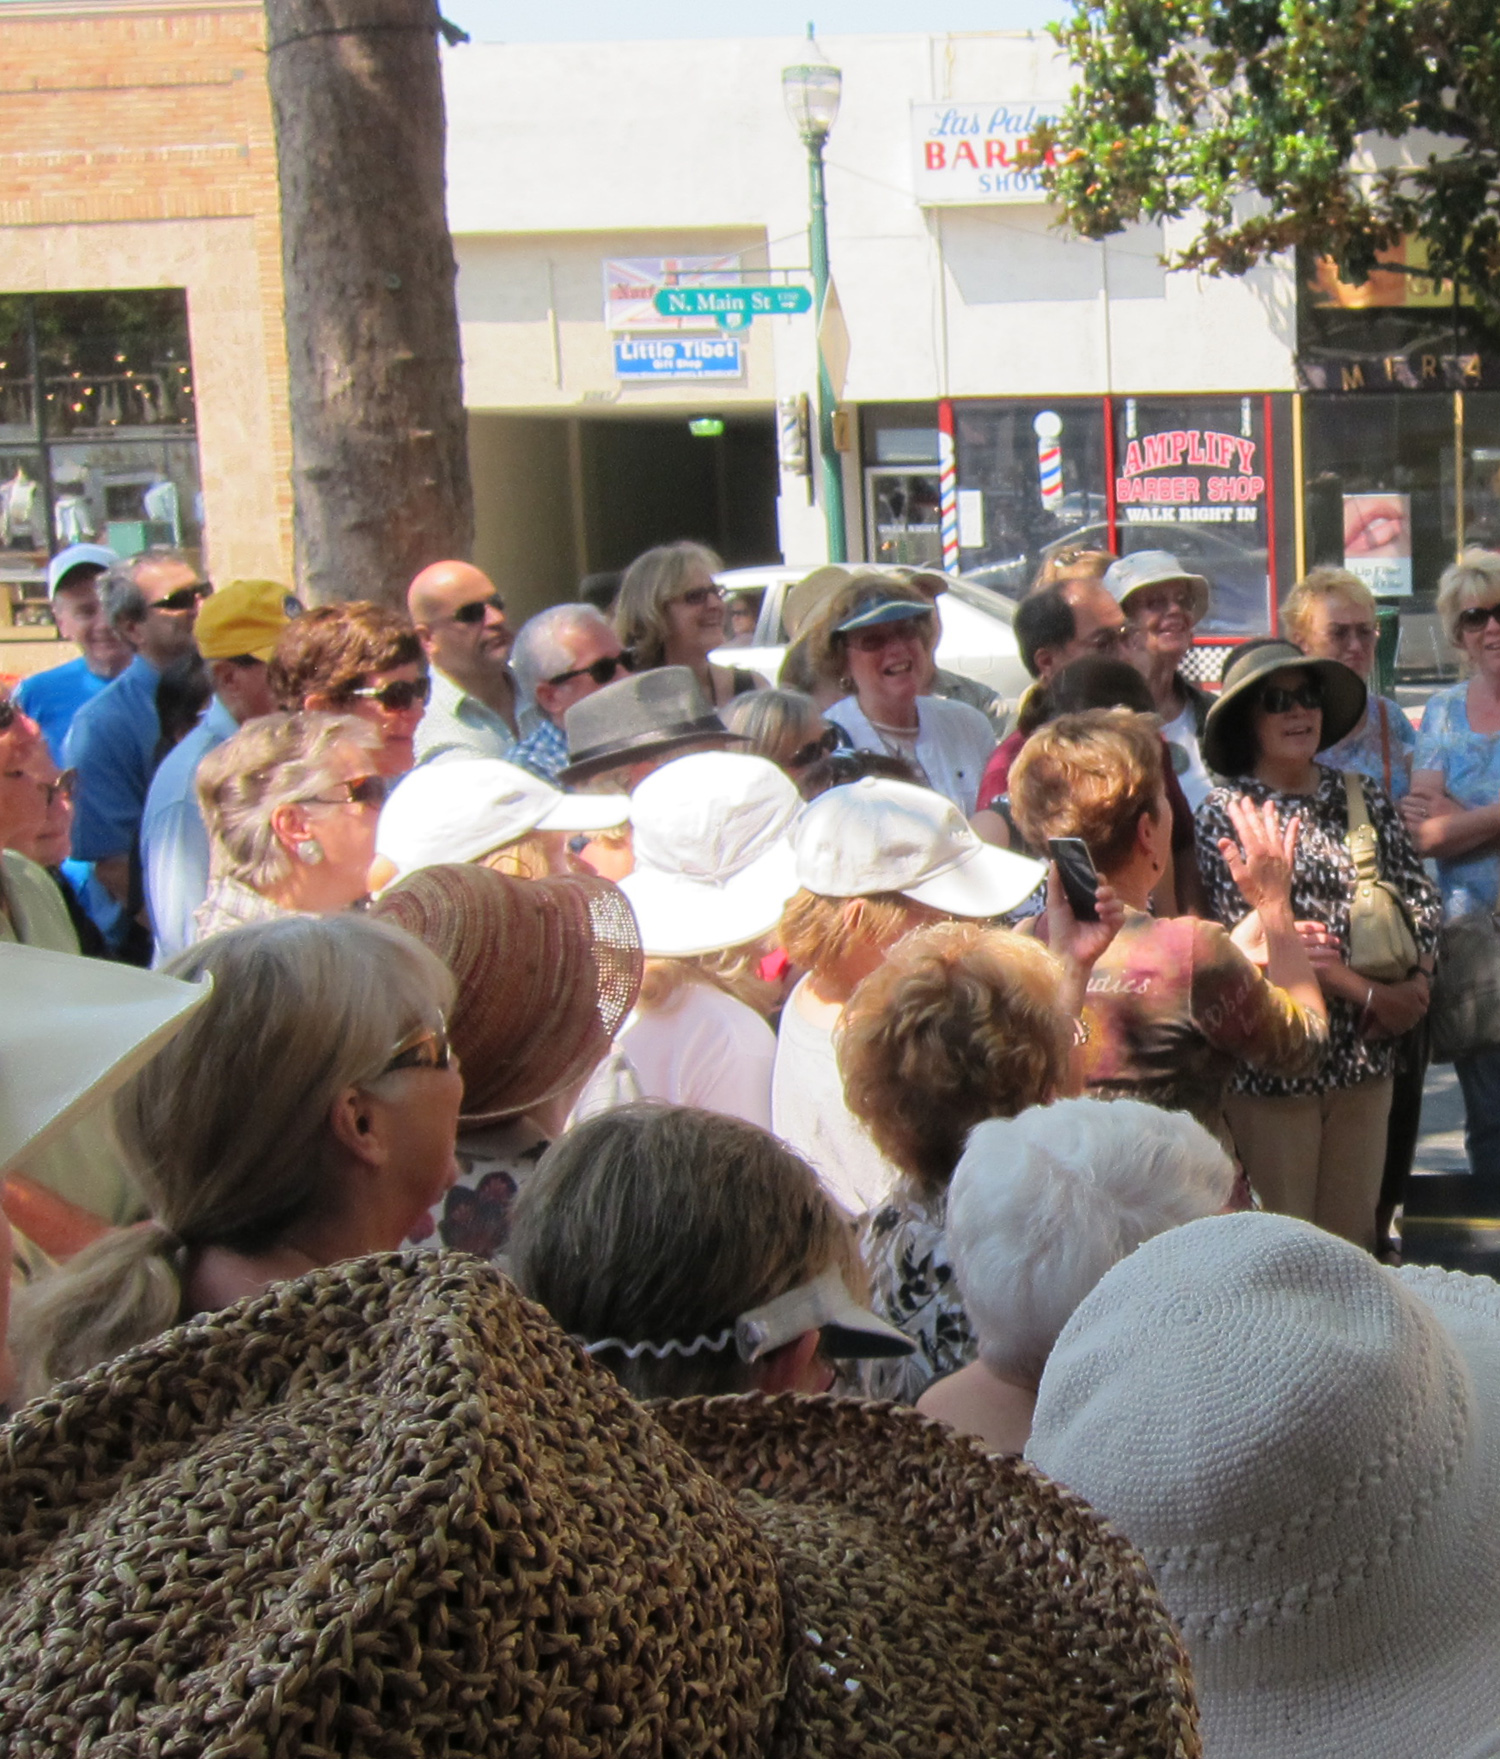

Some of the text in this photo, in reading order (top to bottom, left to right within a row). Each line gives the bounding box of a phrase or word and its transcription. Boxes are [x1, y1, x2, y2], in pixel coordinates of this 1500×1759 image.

[929, 108, 980, 136] Las
[668, 293, 692, 312] N.
[697, 293, 745, 311] Main
[752, 291, 772, 310] St
[621, 341, 734, 360] Little Tibet
[652, 359, 703, 369] Gift Shop
[1122, 430, 1256, 478] AMPLIFY
[1116, 476, 1265, 503] BARBER SHOP
[1126, 507, 1257, 522] WALK RIGHT IN
